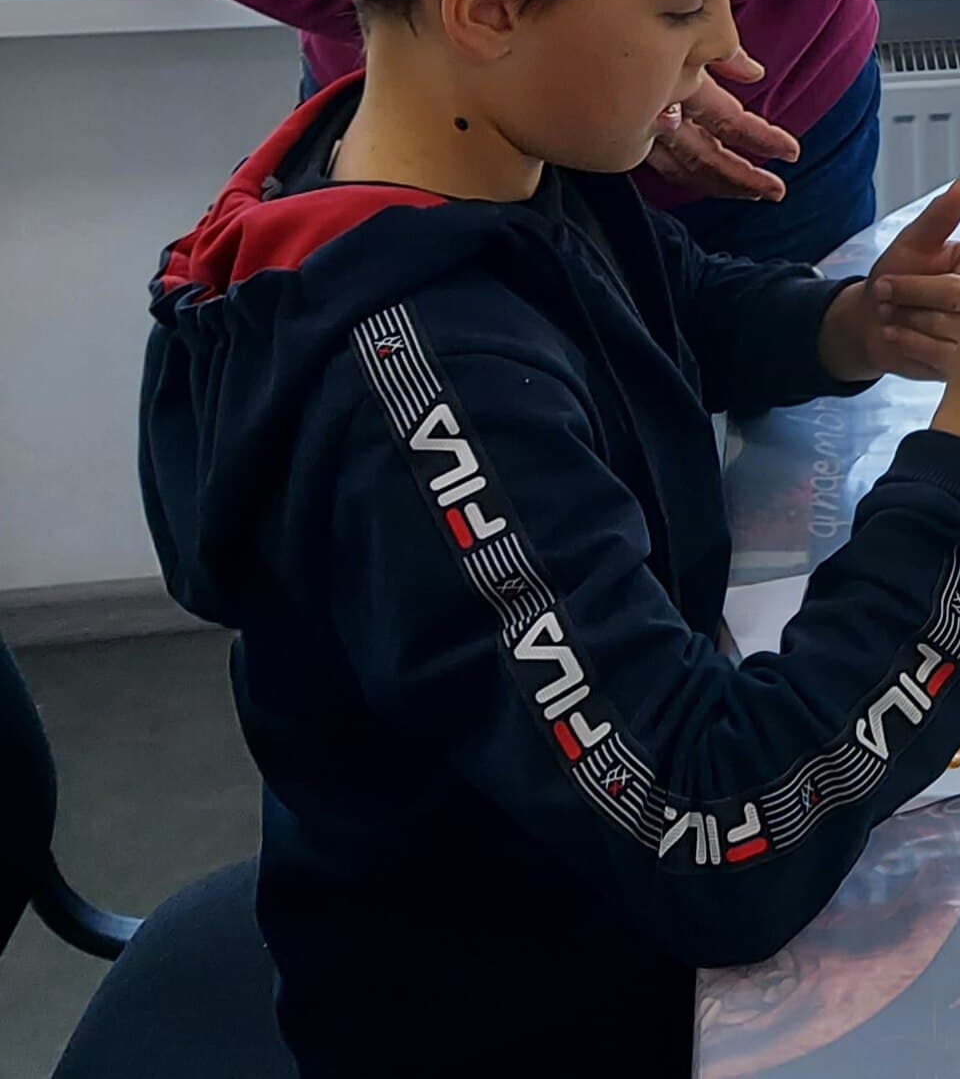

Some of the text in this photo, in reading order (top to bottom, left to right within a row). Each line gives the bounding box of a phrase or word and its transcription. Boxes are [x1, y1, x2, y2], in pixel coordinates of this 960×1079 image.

[409, 403, 507, 549] FILA
[513, 611, 612, 760] FILA
[856, 643, 955, 760] FILA
